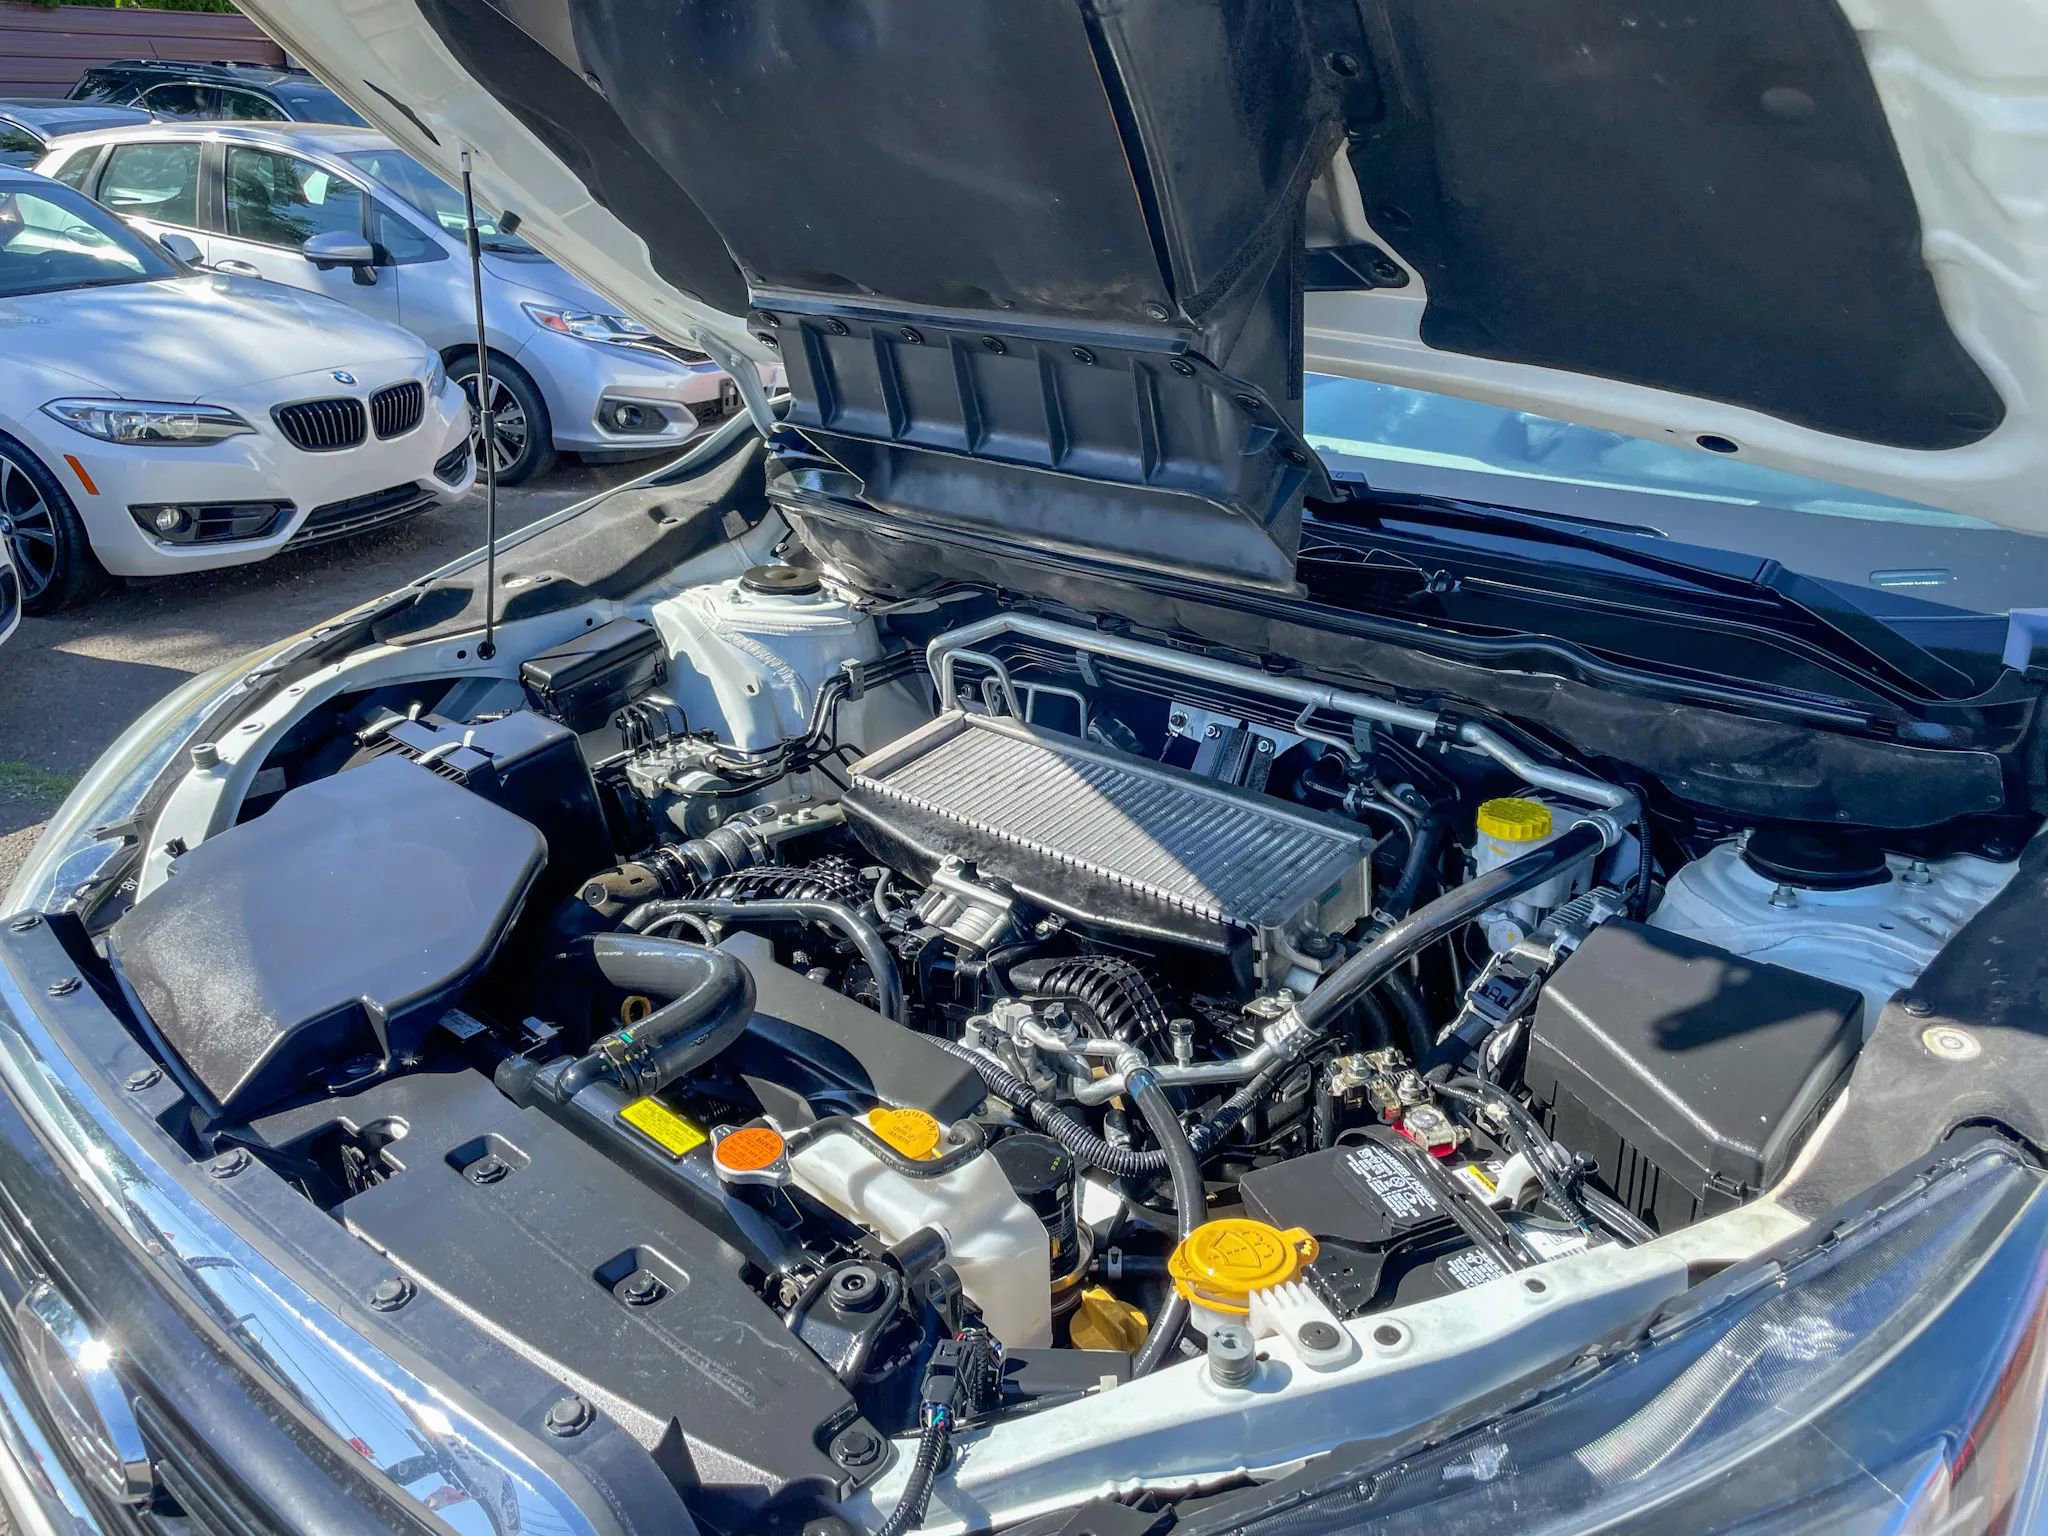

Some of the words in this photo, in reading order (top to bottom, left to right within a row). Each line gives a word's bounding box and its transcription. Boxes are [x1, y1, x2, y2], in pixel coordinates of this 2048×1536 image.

[894, 1110, 938, 1139] COOLANT
[1383, 1151, 1411, 1177] DANGER
[1411, 1180, 1438, 1206] POISON
